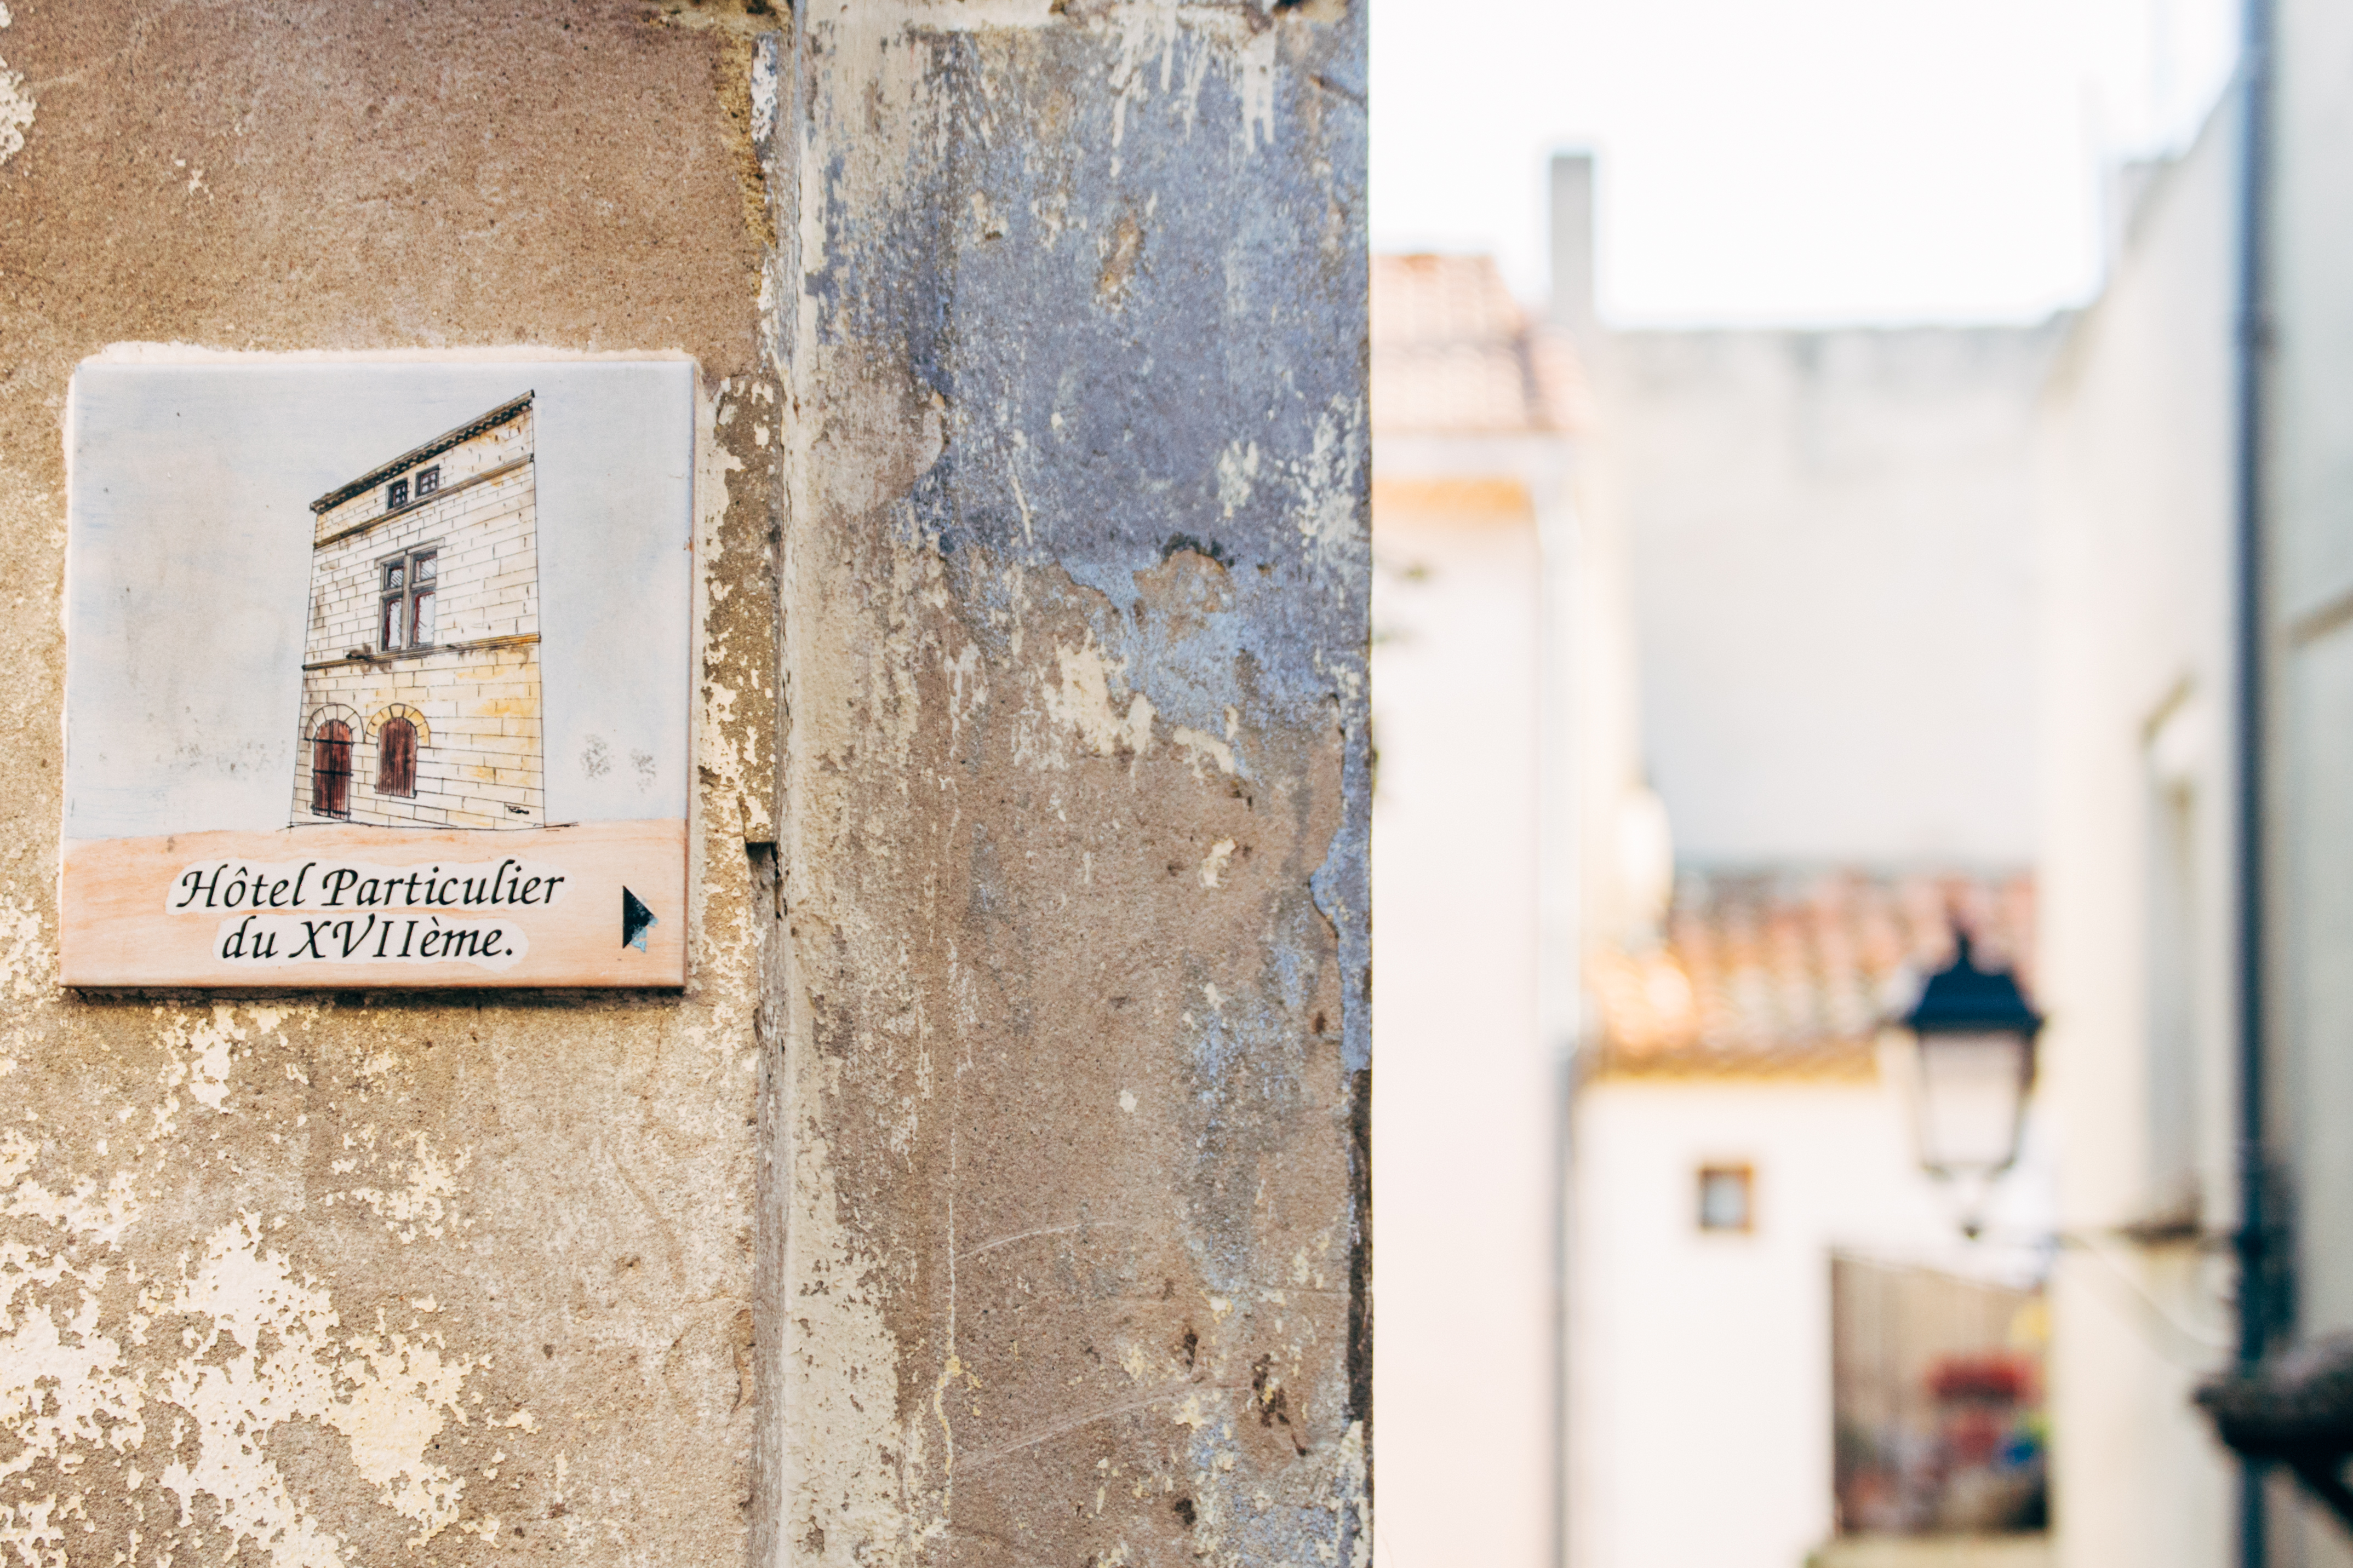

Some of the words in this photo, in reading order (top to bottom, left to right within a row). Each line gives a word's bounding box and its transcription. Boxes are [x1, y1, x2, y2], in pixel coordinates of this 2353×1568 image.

[176, 862, 317, 908] Hôtel
[320, 859, 565, 907] Particulier
[222, 915, 278, 959] du
[288, 912, 513, 959] XVIIème.
